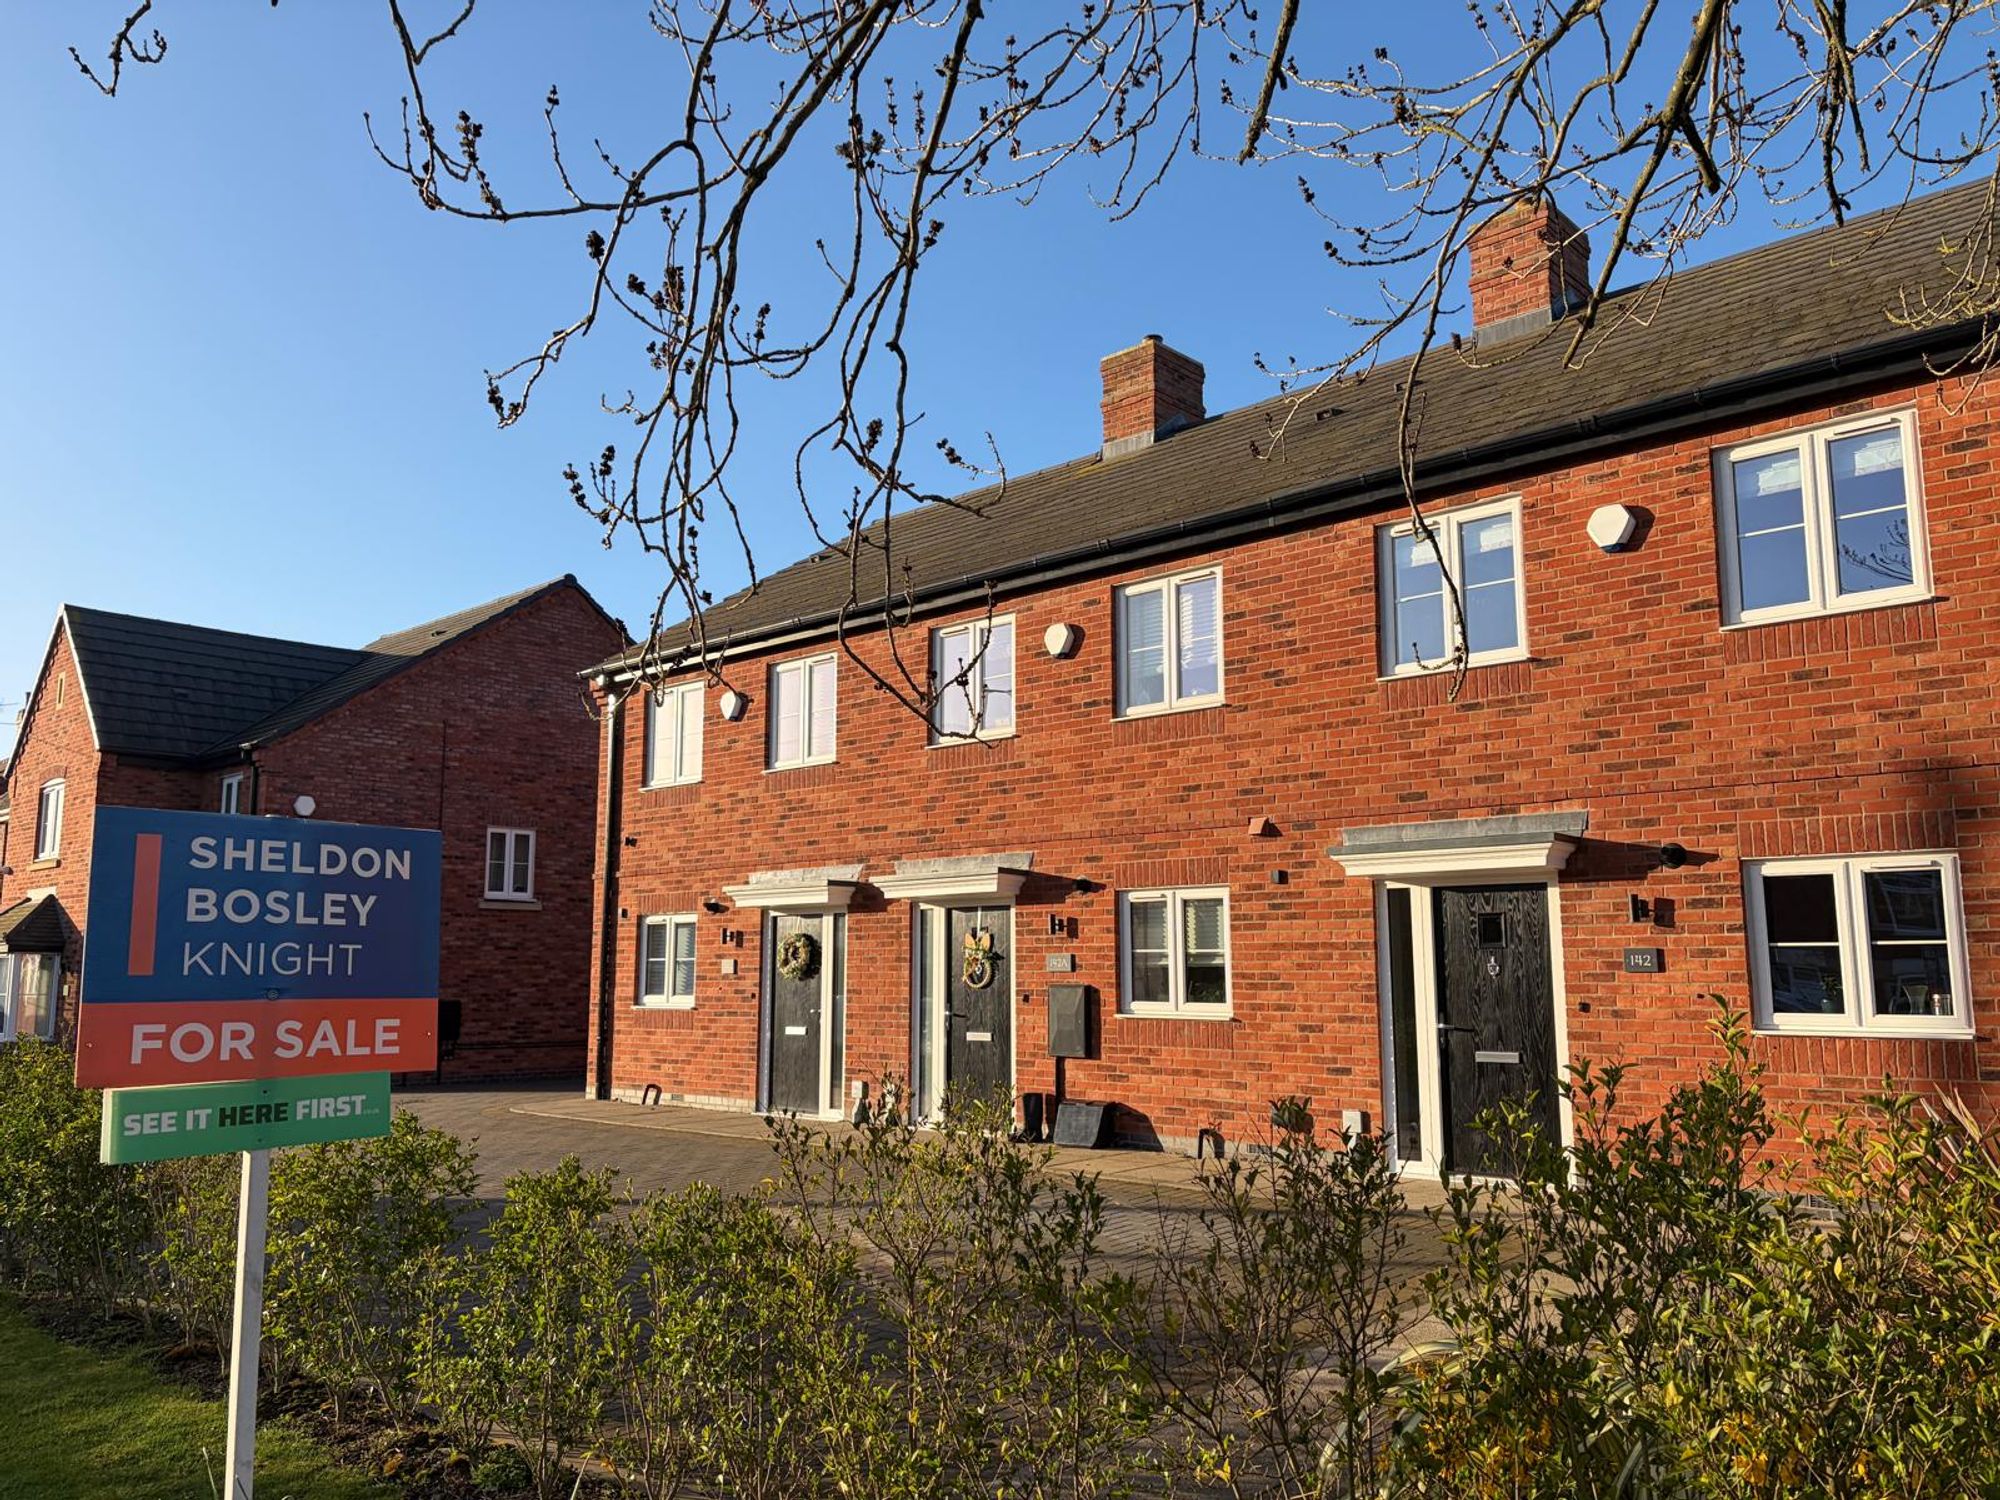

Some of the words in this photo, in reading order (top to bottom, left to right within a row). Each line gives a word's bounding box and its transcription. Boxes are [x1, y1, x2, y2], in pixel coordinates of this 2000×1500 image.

[189, 837, 411, 880] SHELDON
[187, 888, 377, 926] BOSLEY
[183, 942, 363, 976] KNIGHT
[1630, 955, 1651, 966] 142
[131, 1022, 255, 1065] FOR
[274, 1018, 400, 1059] SALE
[123, 1112, 177, 1137] SEE
[185, 1109, 212, 1130] IT
[218, 1102, 289, 1128] HERE
[296, 1095, 366, 1121] FIRST
